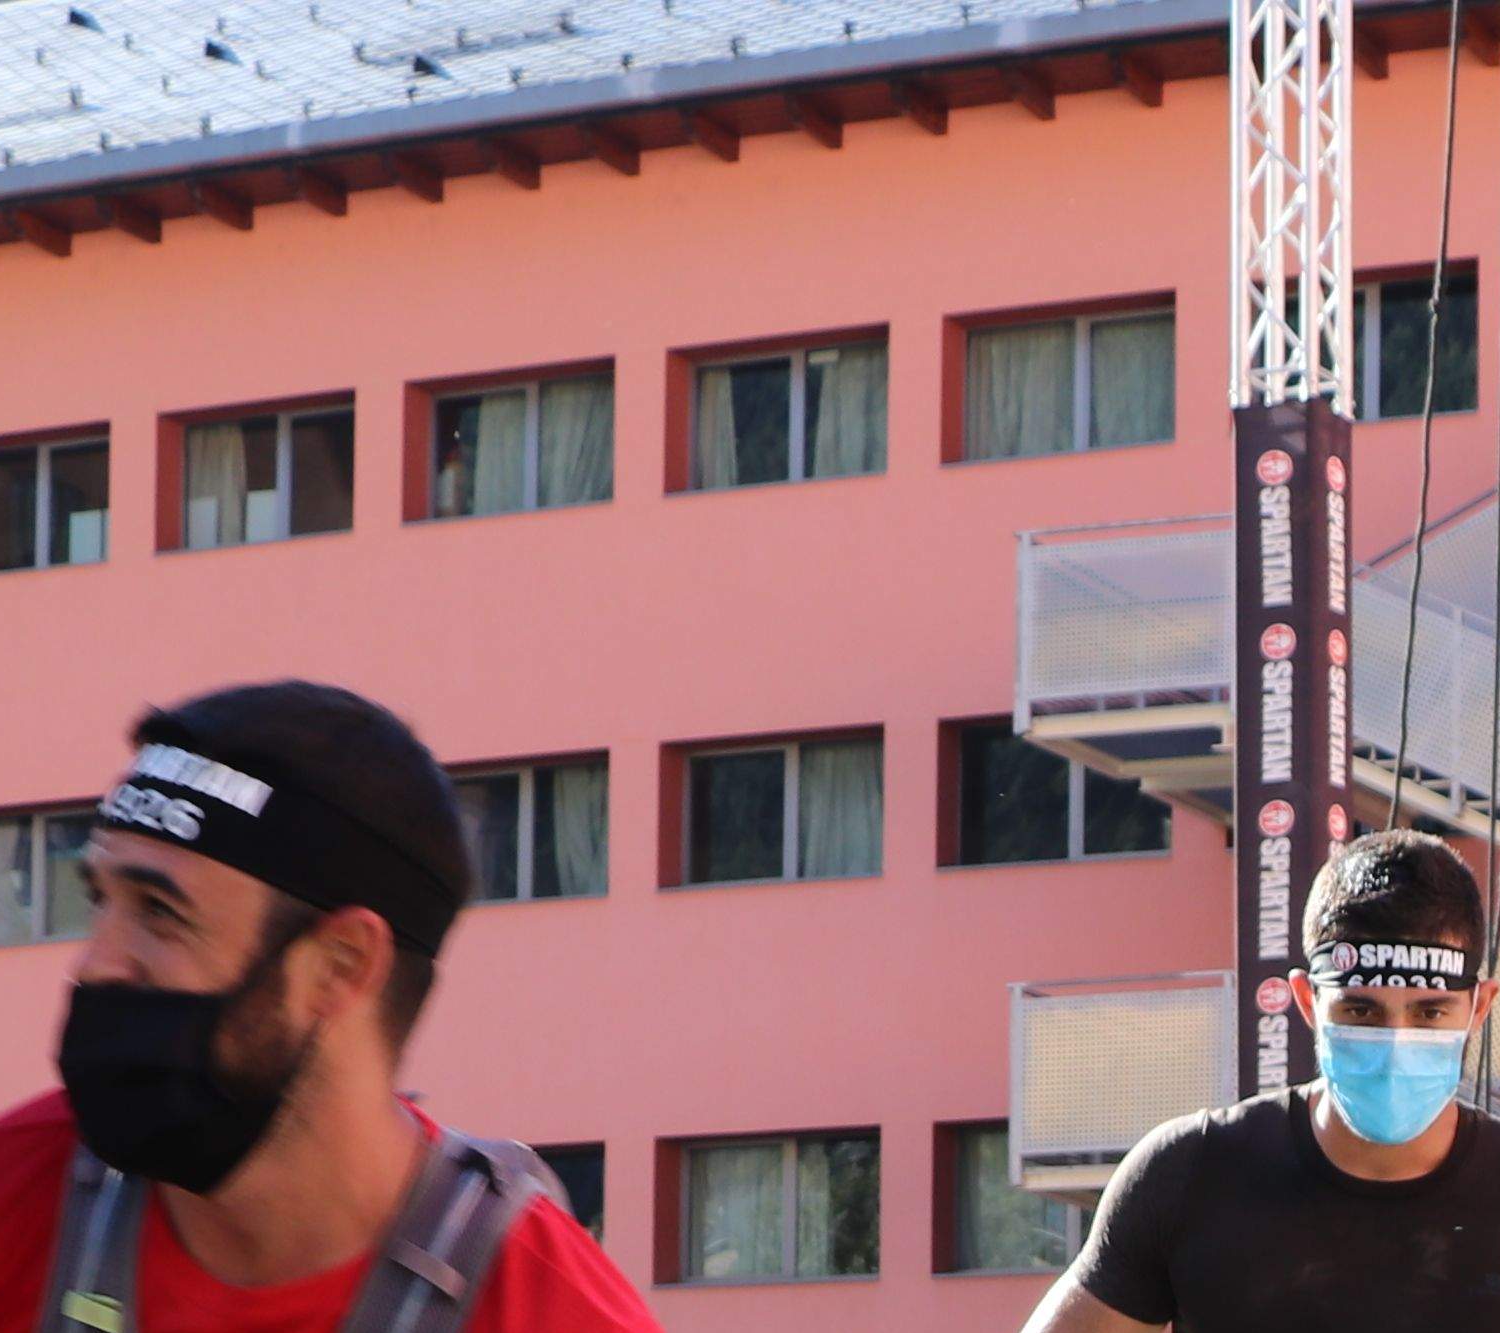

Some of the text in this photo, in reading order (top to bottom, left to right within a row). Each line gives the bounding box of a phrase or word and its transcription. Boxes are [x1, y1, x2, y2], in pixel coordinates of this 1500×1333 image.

[1259, 486, 1293, 608] SPARTAN
[1327, 490, 1345, 614] SPARTAN
[1261, 659, 1293, 784] SPARTAN
[1328, 666, 1346, 788] SPARTAN
[1258, 836, 1291, 960] SPARTAN
[1359, 943, 1465, 976] SPARTAN
